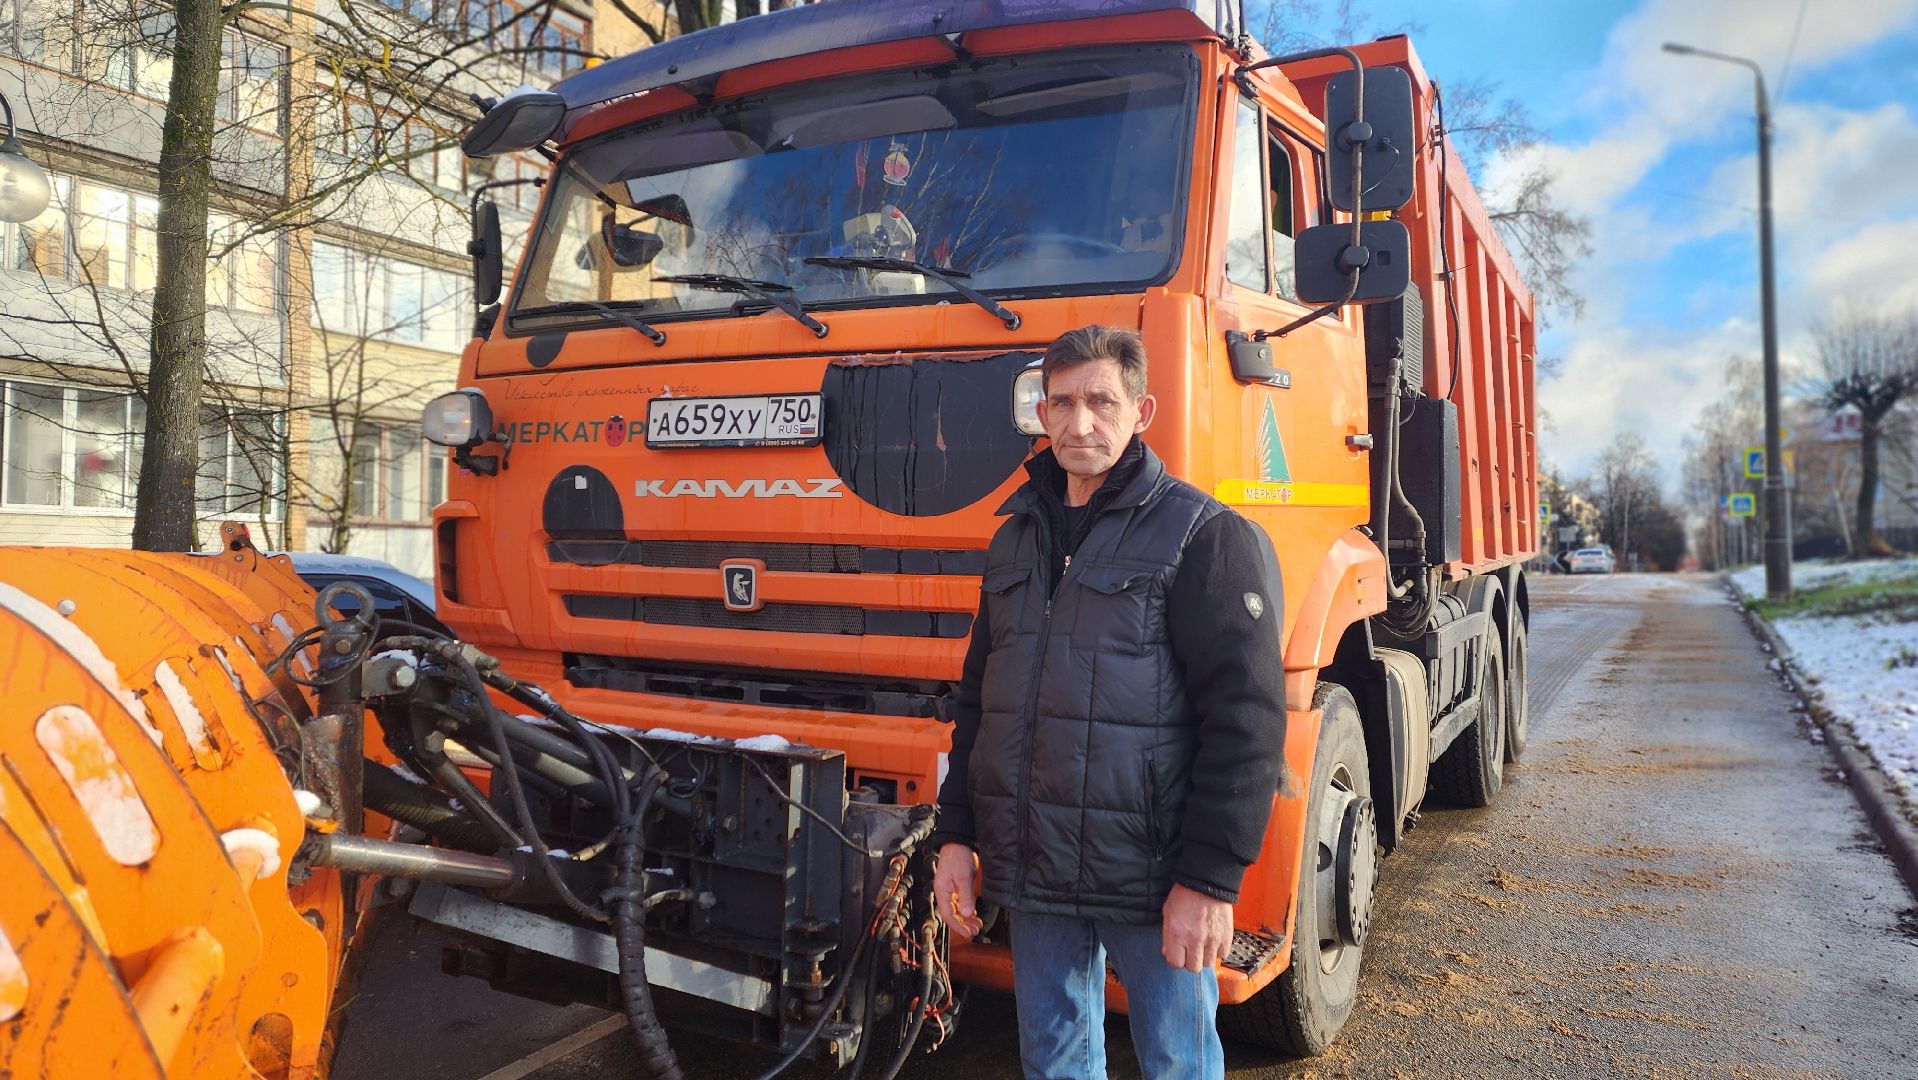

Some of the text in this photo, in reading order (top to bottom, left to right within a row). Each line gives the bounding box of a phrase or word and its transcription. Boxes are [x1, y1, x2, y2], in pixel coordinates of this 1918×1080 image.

[1268, 373, 1290, 386] 20
[656, 398, 811, 437] А659ХУ 750
[778, 424, 799, 434] RUS
[635, 479, 843, 498] KAMAZ
